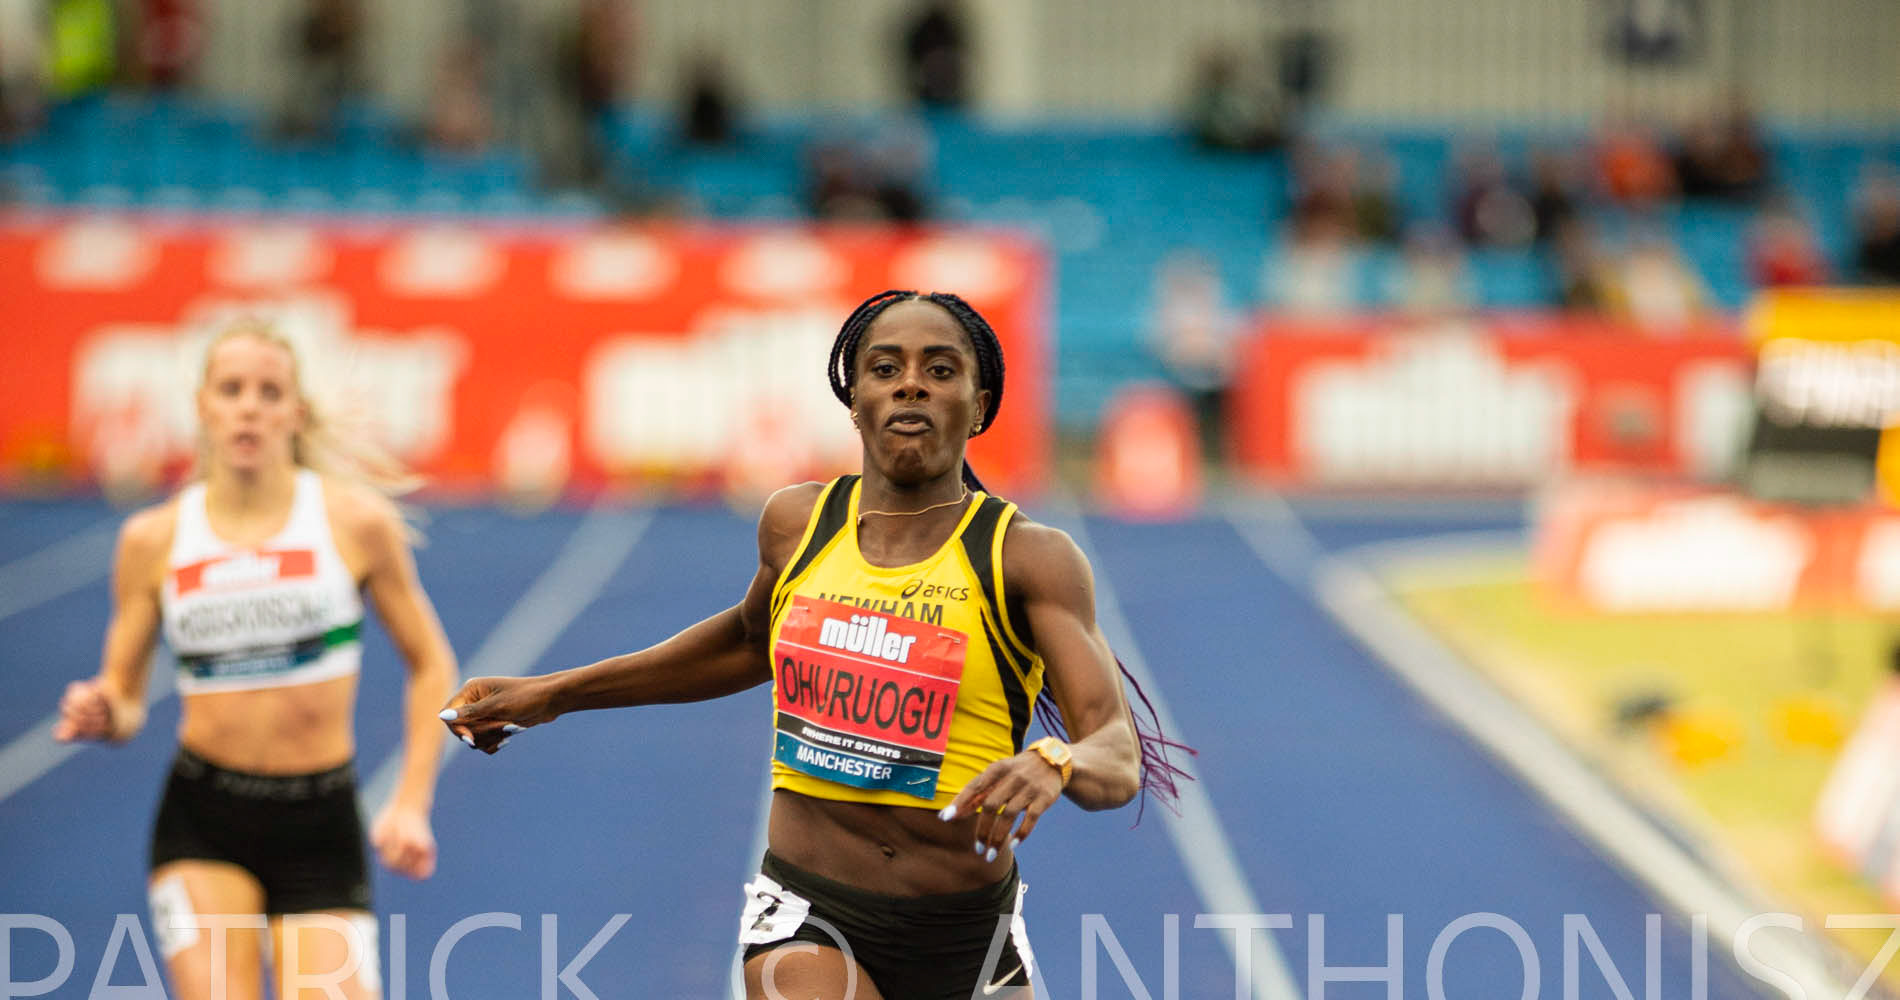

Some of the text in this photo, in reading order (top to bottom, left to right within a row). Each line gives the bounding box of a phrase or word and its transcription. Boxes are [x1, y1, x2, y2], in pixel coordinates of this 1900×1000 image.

[819, 592, 944, 627] HAM
[923, 584, 969, 601] asics
[818, 614, 917, 664] müller
[781, 657, 950, 740] OHURUOGU
[796, 744, 892, 780] MANCHESTER
[854, 741, 901, 759] STARTS
